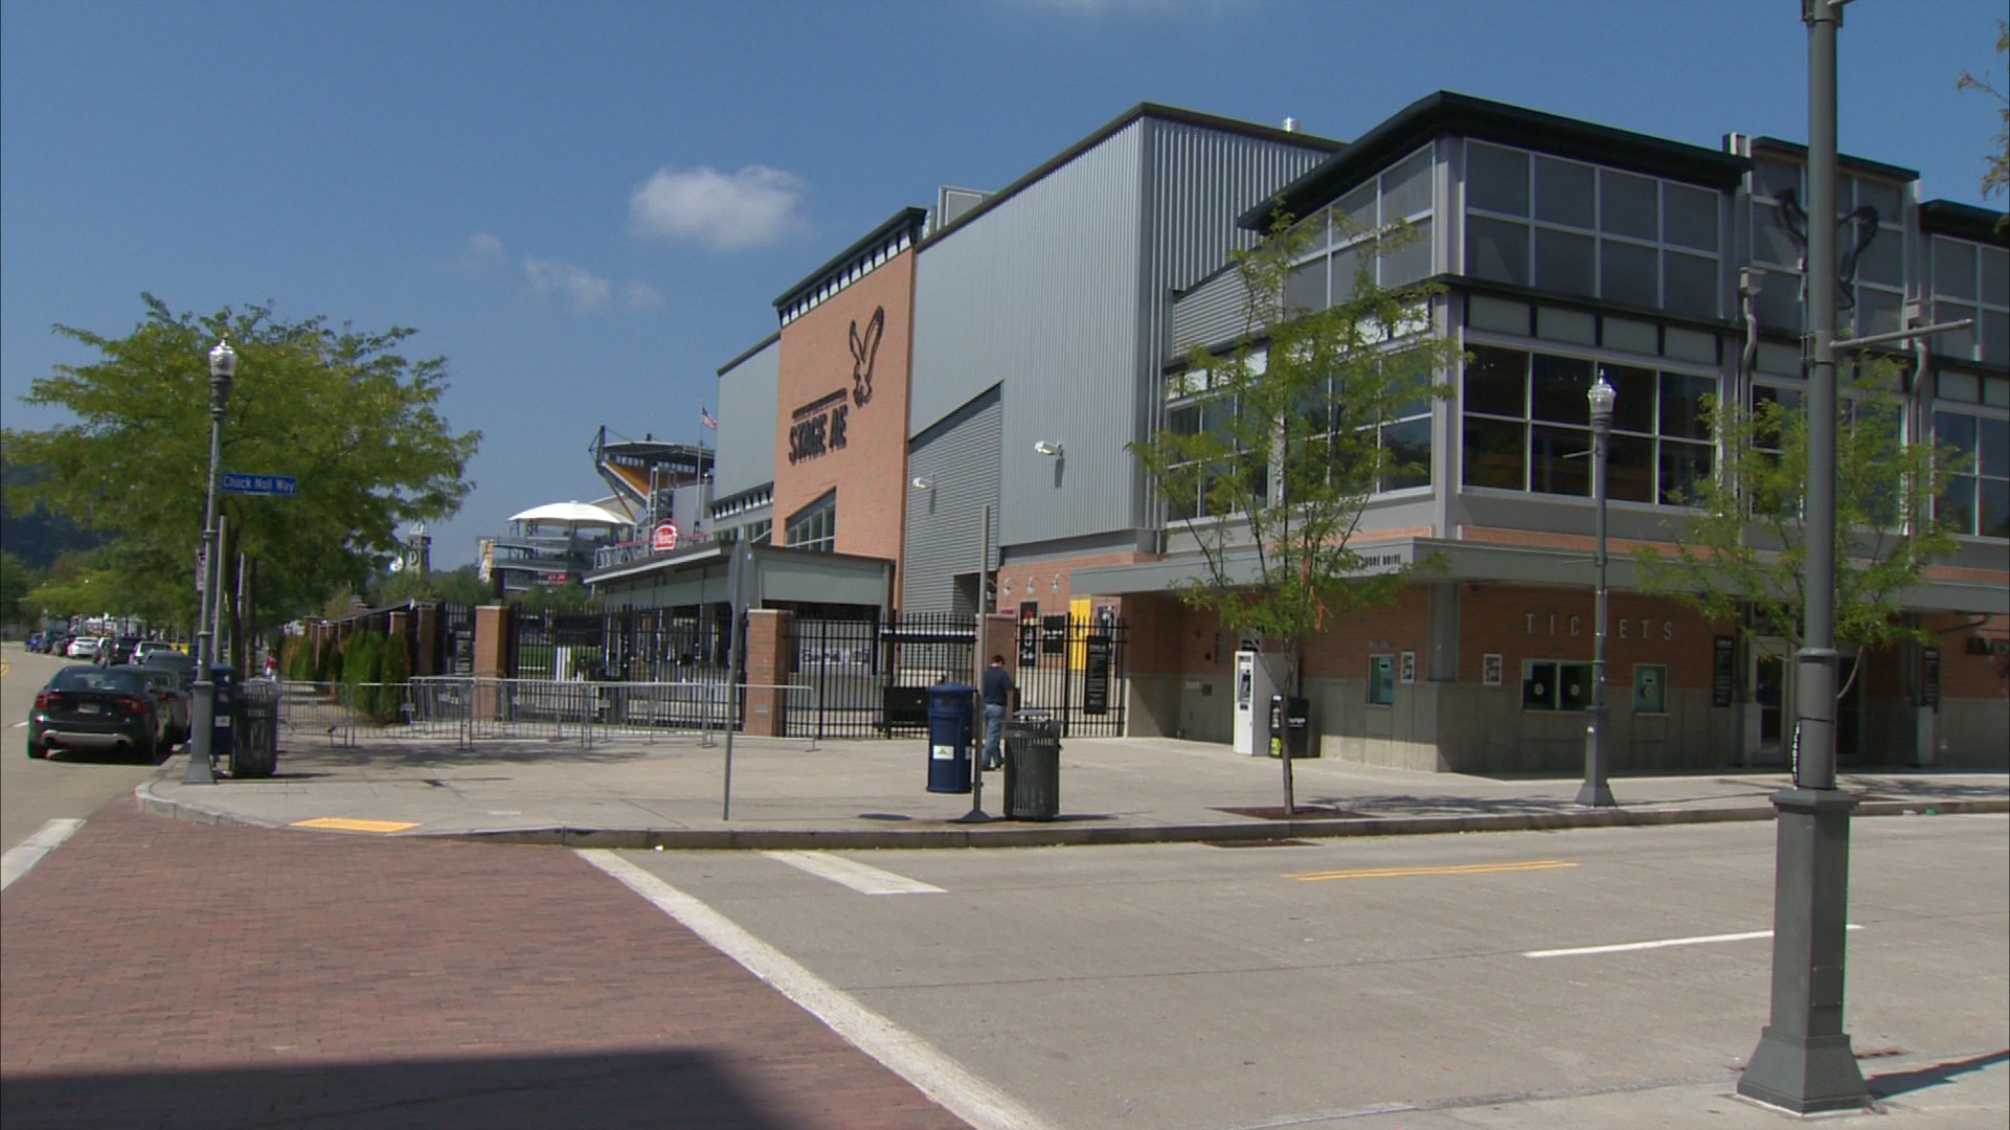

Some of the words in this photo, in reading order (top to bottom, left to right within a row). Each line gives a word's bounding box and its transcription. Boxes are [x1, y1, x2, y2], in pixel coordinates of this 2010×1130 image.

[789, 413, 827, 466] STAGE
[829, 403, 848, 450] AE
[223, 475, 254, 489] Chuck
[275, 478, 297, 495] Way
[1525, 613, 1673, 640] TICETS
